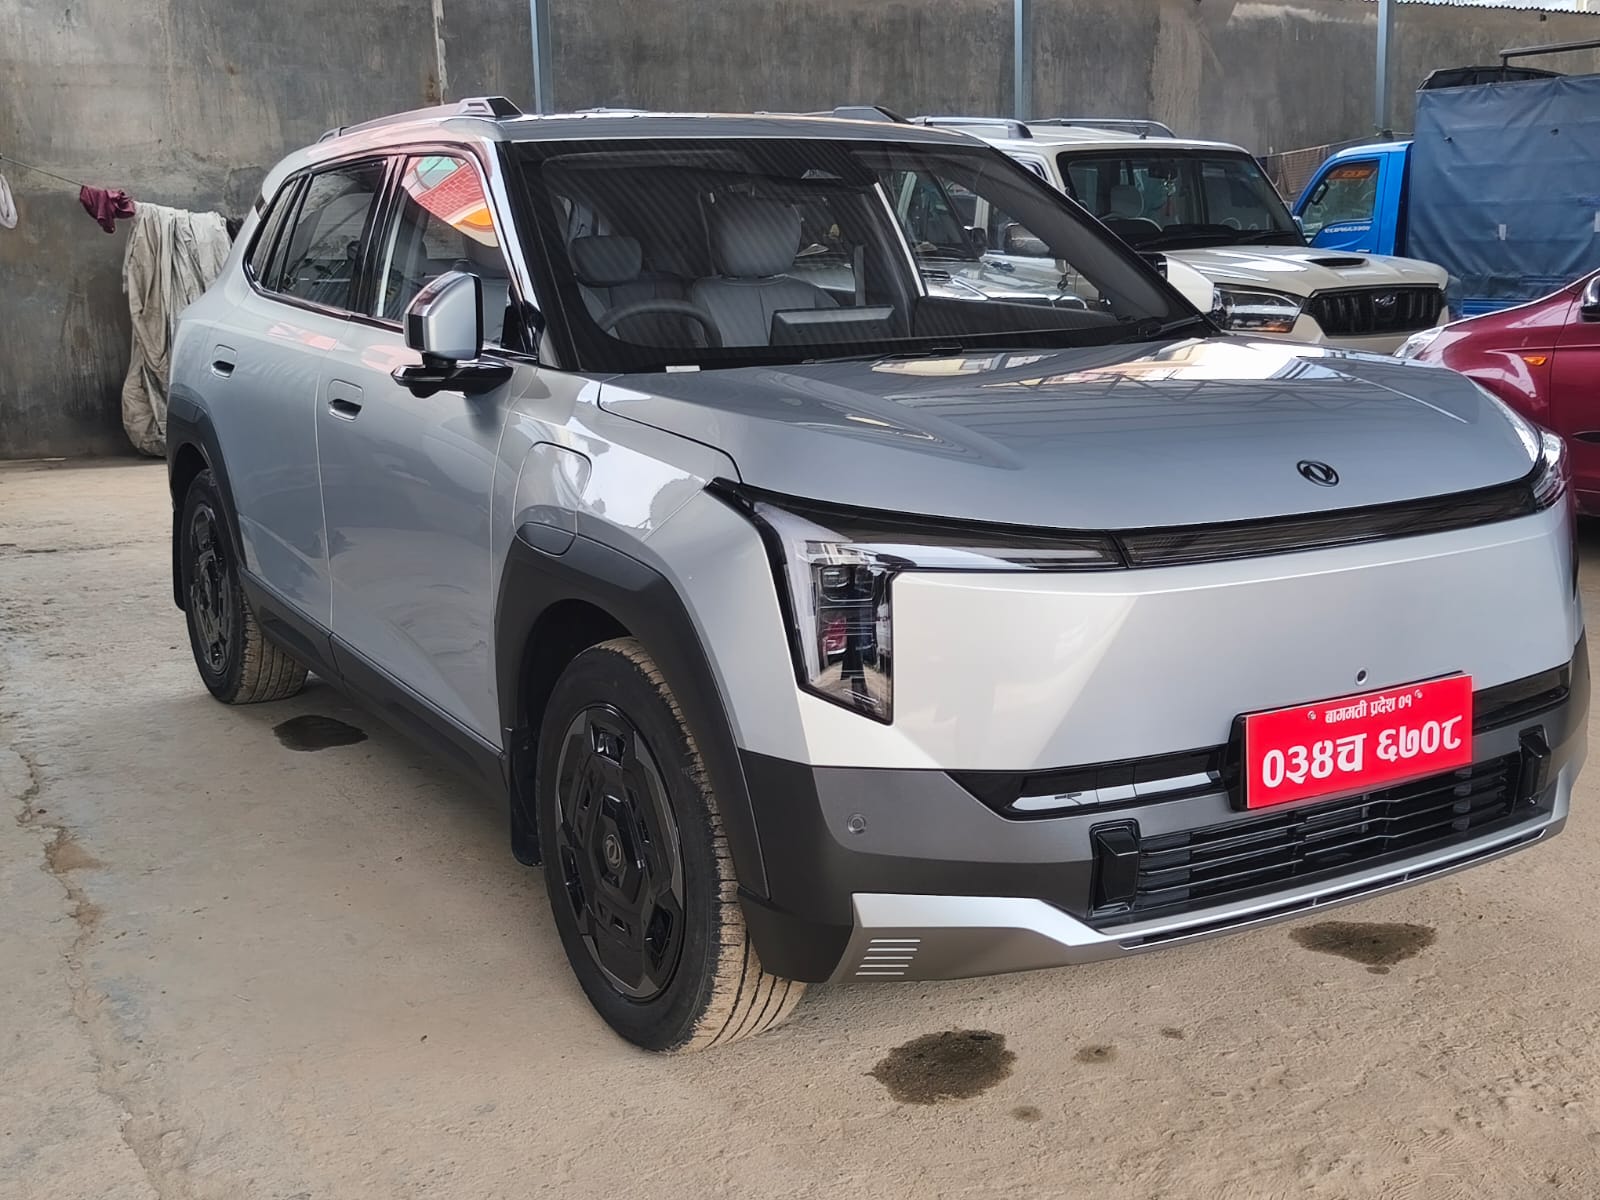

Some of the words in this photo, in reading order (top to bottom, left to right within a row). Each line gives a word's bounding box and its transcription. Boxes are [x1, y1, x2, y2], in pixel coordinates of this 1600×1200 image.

[1325, 699, 1368, 724] बागमती
[1370, 696, 1397, 717] प्रदेश
[1398, 694, 1412, 709] ०१
[1262, 732, 1367, 788] ०३४च
[1376, 715, 1462, 762] ६७०८
